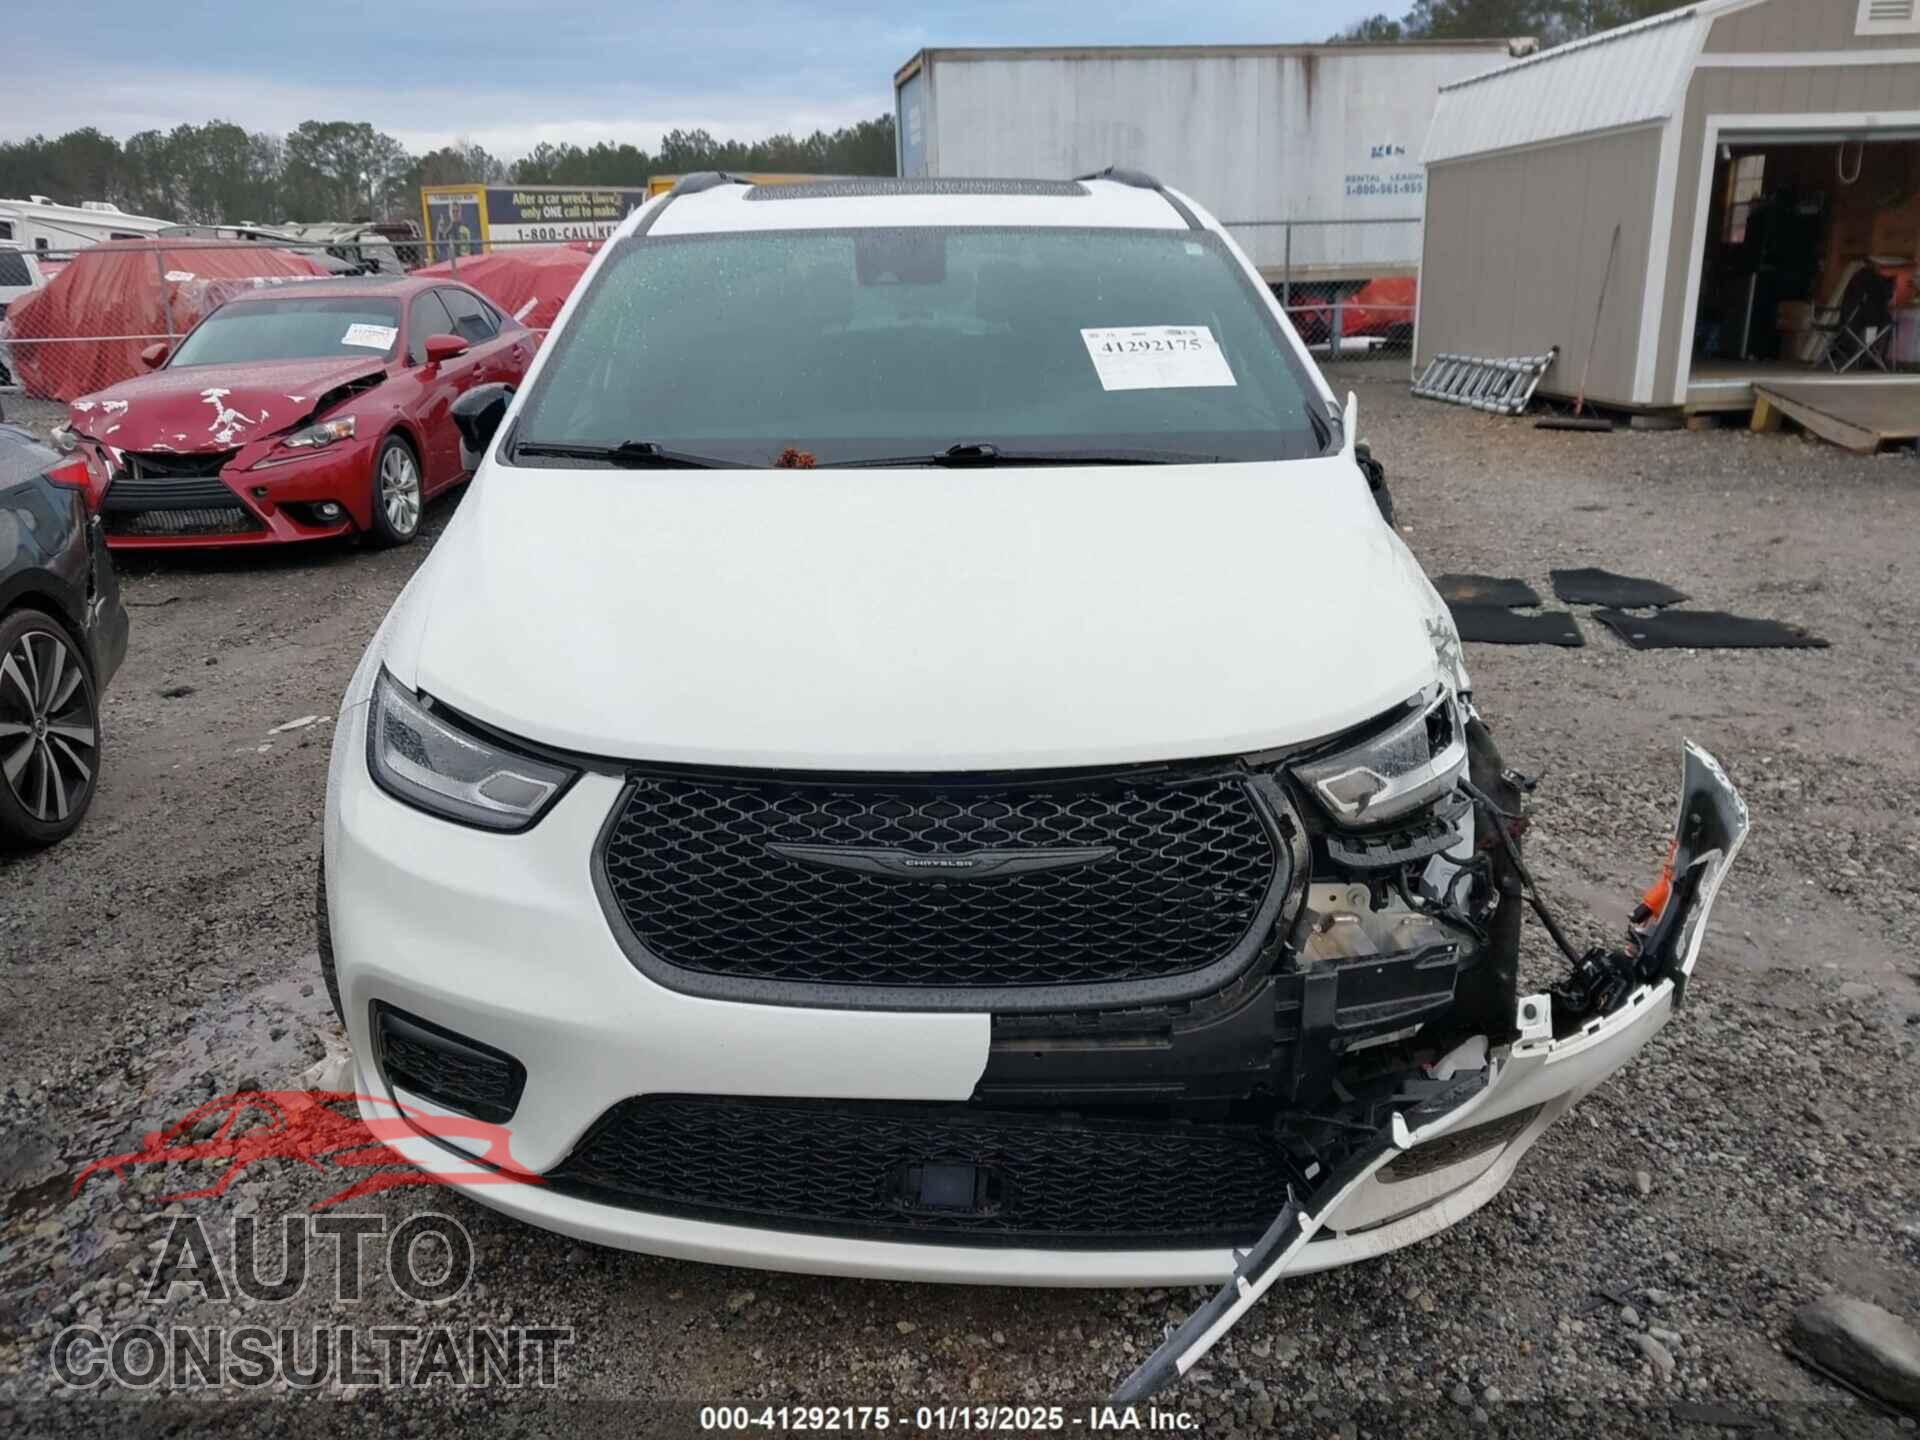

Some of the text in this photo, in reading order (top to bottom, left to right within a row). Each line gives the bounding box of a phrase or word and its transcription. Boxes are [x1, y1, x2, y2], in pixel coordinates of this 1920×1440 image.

[512, 192, 535, 205] After
[545, 195, 559, 204] car
[521, 207, 541, 221] only
[543, 206, 563, 218] ONE
[564, 206, 580, 217] call
[582, 206, 592, 217] to
[1101, 338, 1202, 353] 41292175
[905, 859, 973, 867] CHRYSLER
